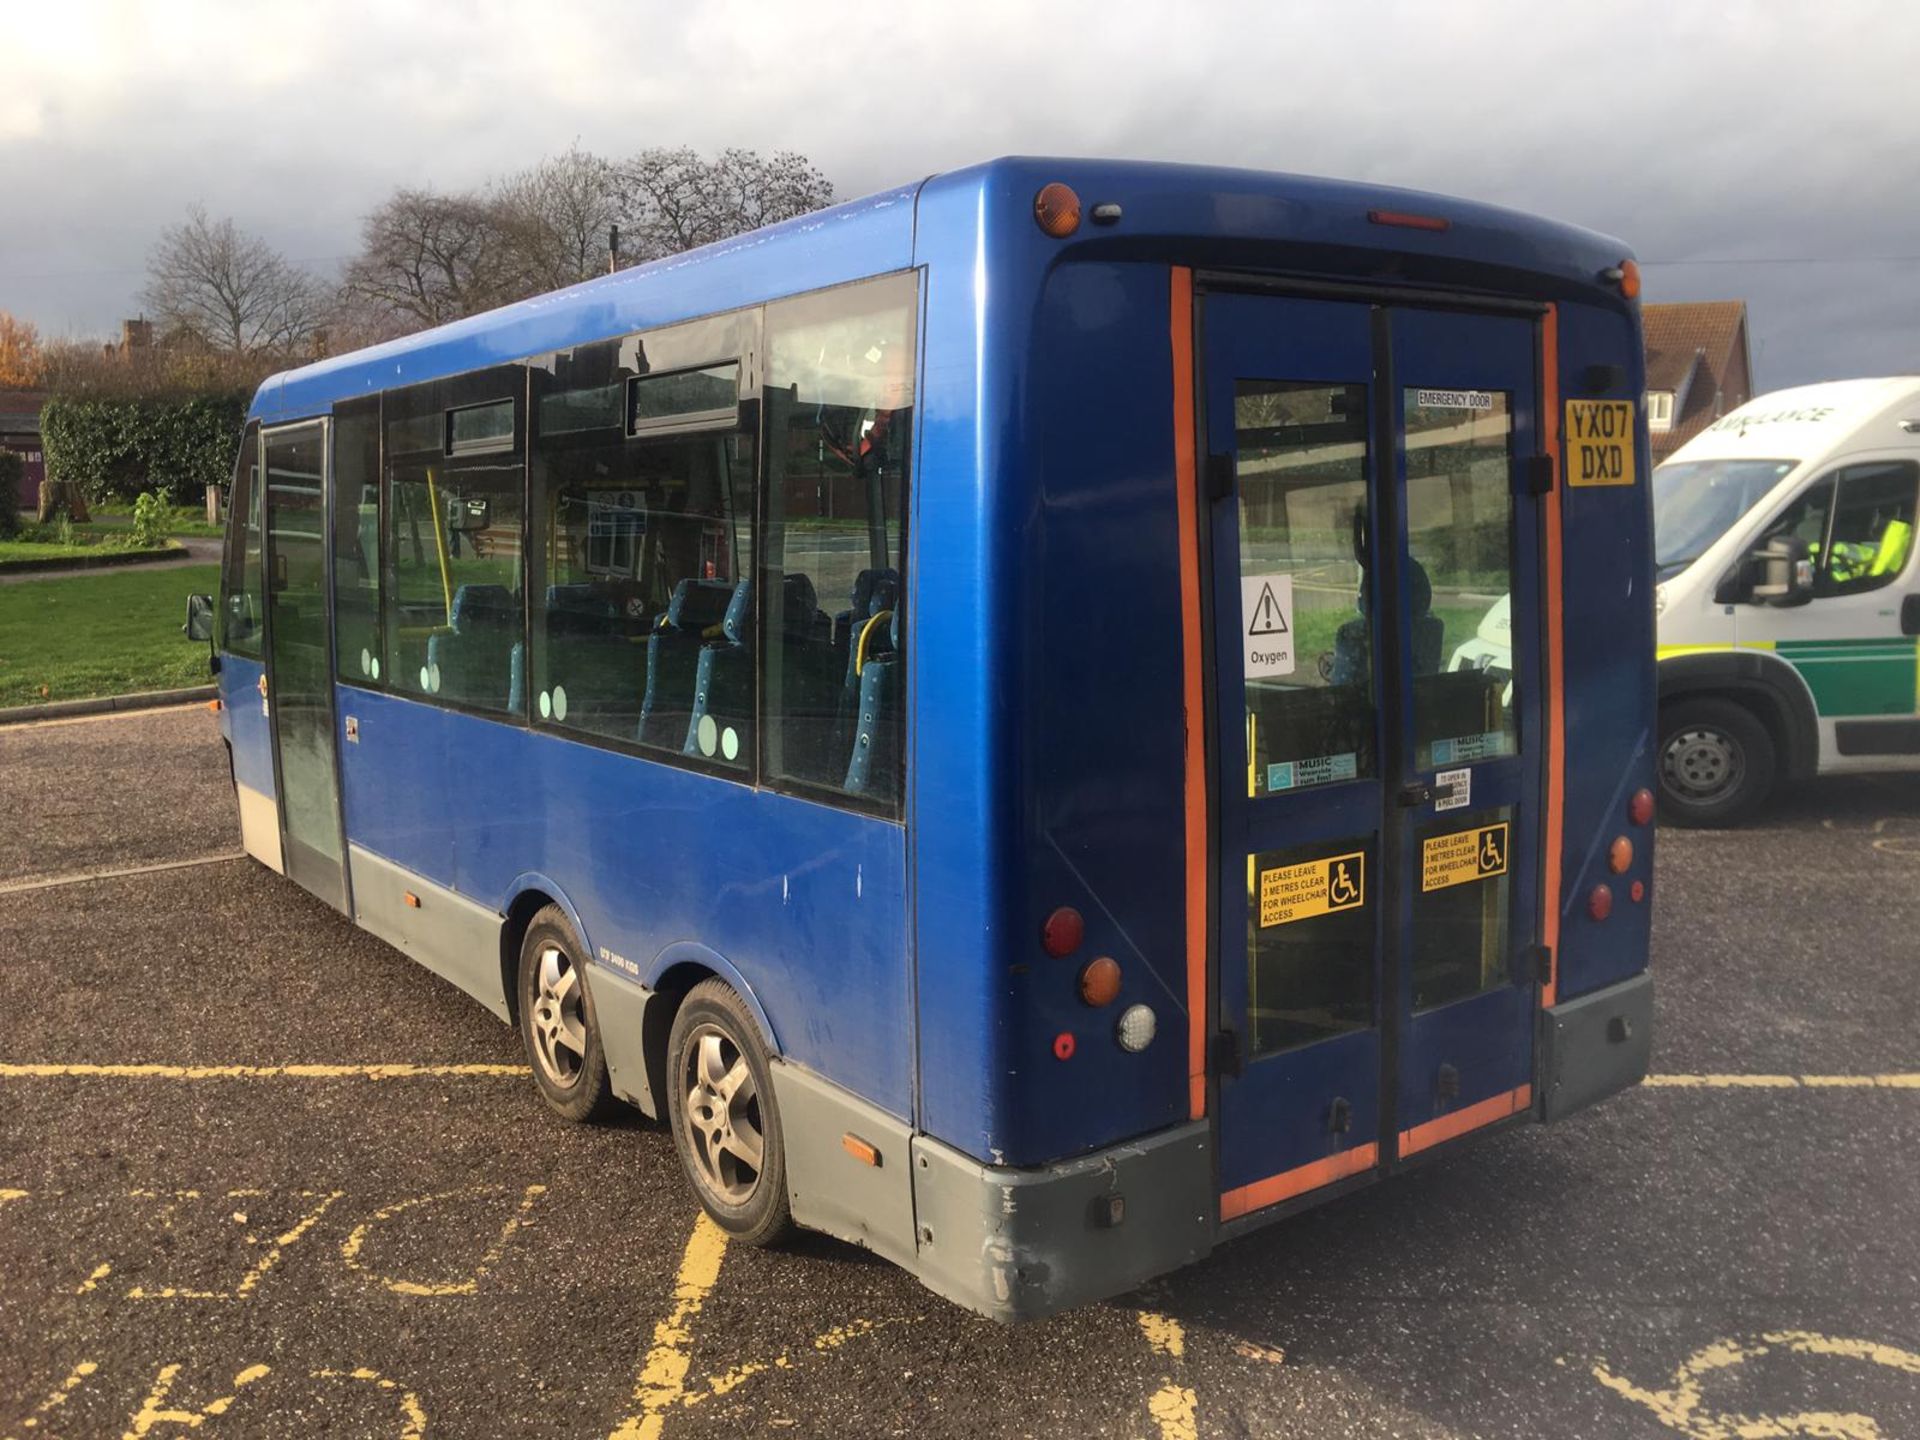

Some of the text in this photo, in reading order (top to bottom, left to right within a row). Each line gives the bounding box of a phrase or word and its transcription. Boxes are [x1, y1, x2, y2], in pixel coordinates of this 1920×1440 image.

[1420, 391, 1489, 407] EMERGENCY DOOR
[1573, 404, 1627, 438] YX07
[1581, 445, 1622, 479] DXD
[1251, 651, 1287, 665] Oxygen
[1458, 734, 1485, 745] MUSIC
[1299, 757, 1332, 769] MUSIC
[1426, 834, 1469, 851] PLEASE LEAVE
[1431, 850, 1454, 862] METRES
[1455, 845, 1475, 857] CLEAR
[1264, 864, 1316, 884] PLEASE LEAVE
[1426, 856, 1477, 875] FOR WHEELCHAIR
[1263, 876, 1325, 897] 3 METRES CLEAR
[1426, 874, 1449, 886] ACCESS
[1264, 888, 1328, 910] FOR WHEELCHAIR
[1264, 909, 1293, 923] ACCESS
